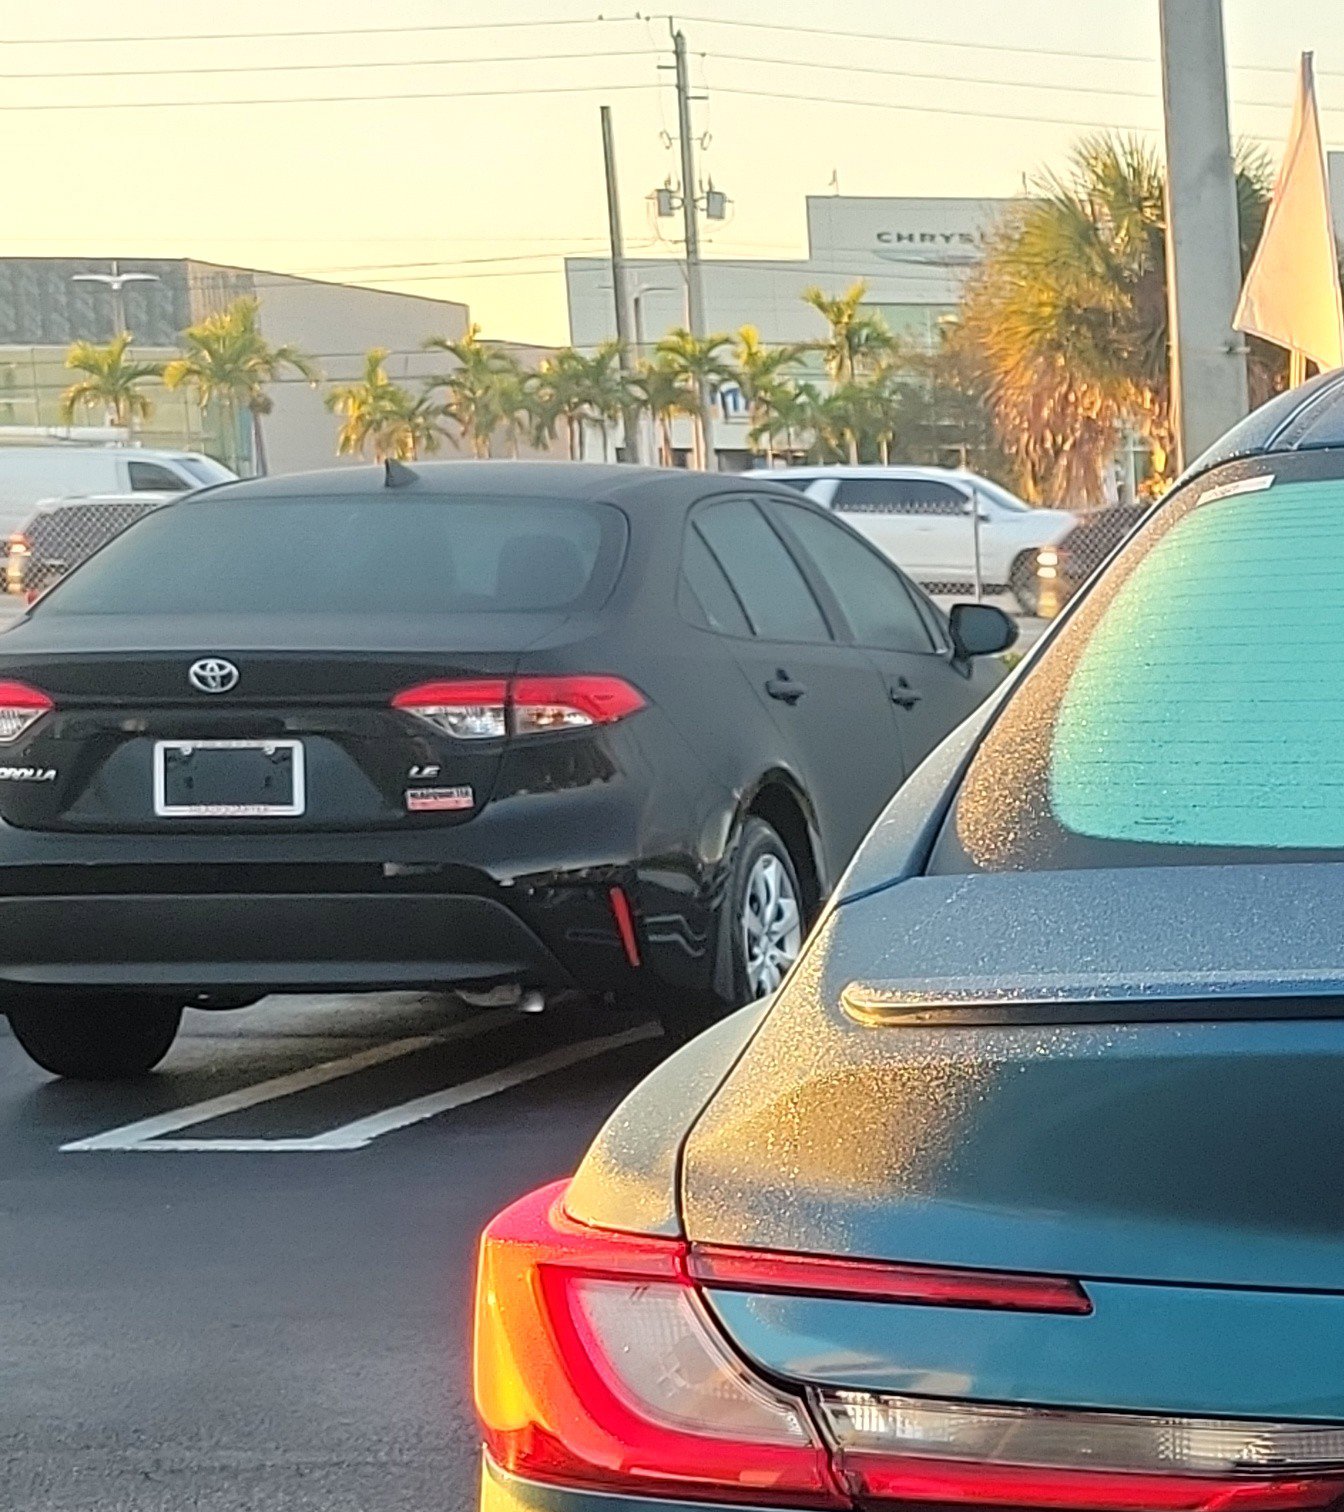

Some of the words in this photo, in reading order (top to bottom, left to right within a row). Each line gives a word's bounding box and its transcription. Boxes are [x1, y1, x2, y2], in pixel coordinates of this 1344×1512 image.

[876, 232, 996, 243] CHRYSL
[0, 767, 57, 780] OROLLA
[408, 765, 441, 779] LE
